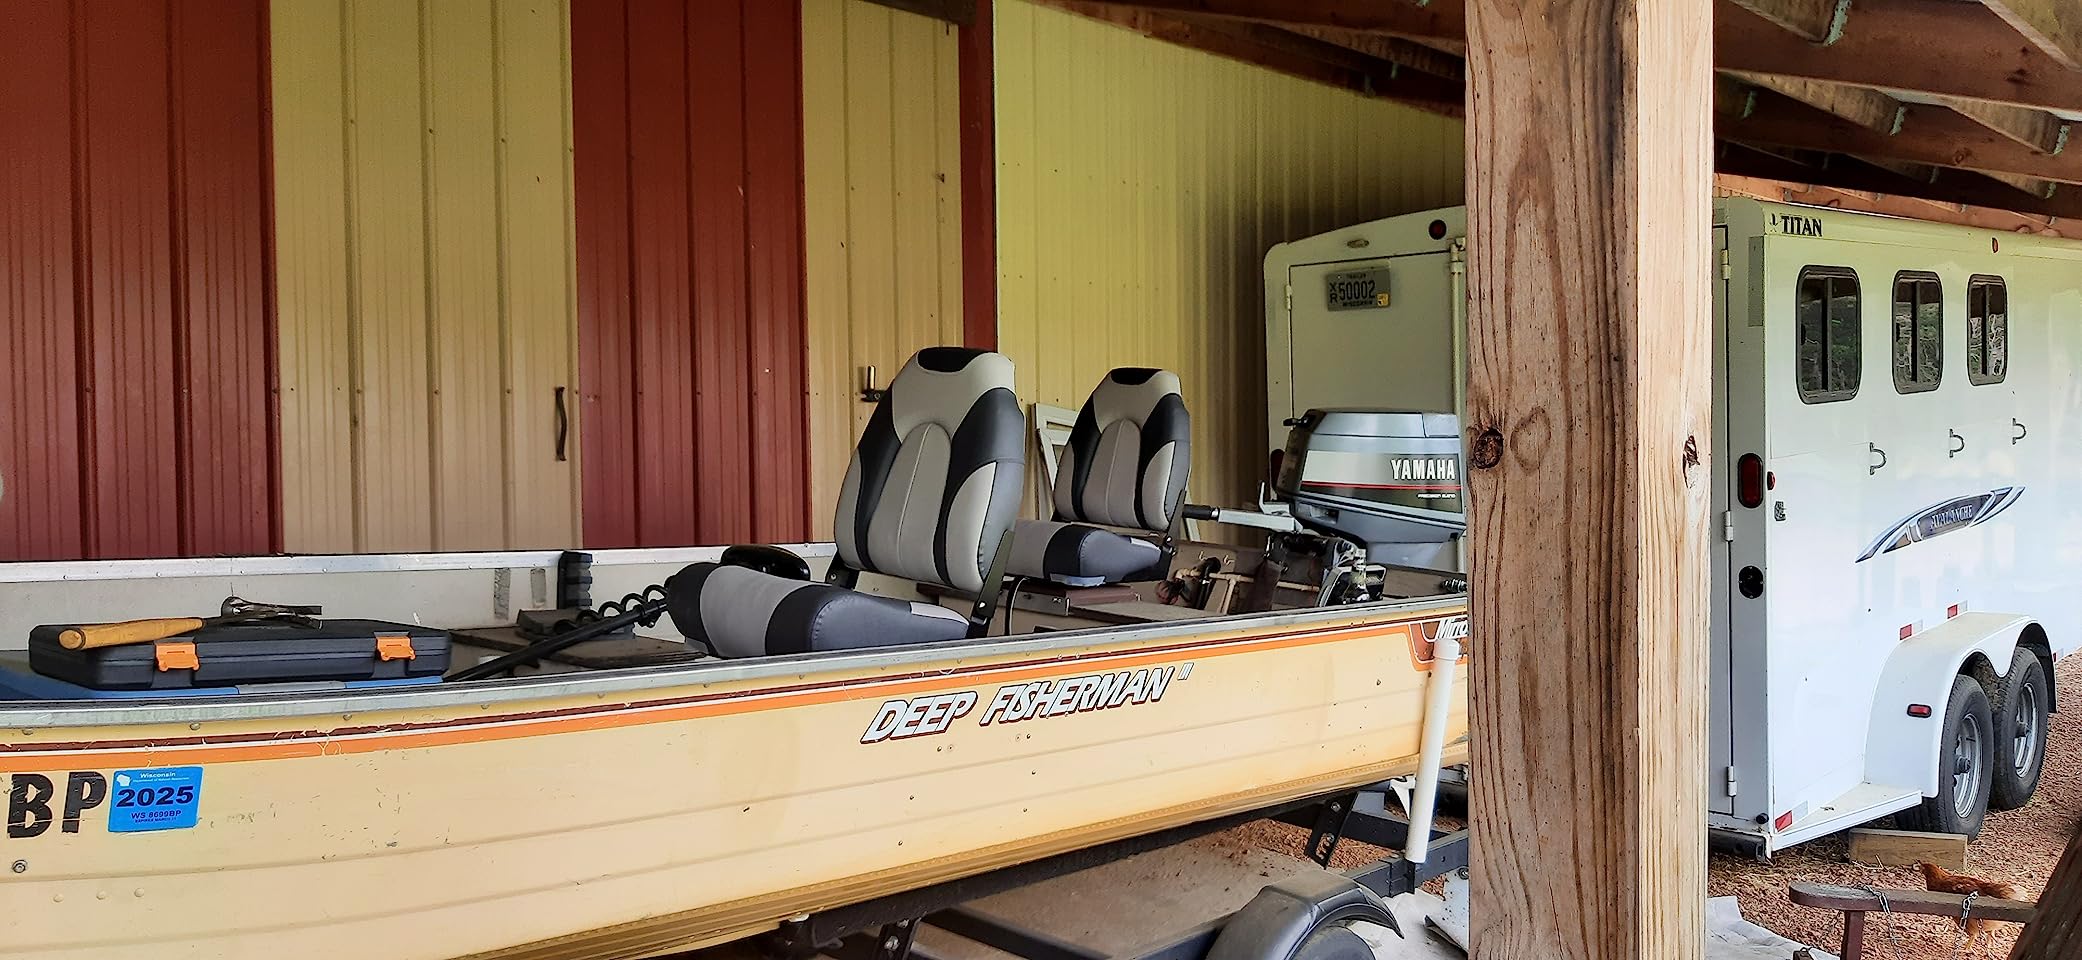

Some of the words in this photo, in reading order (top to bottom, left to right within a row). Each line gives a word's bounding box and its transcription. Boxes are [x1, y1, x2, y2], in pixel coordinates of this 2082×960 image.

[1780, 215, 1823, 238] TITAN
[1338, 280, 1376, 300] 50002
[1390, 458, 1456, 480] YAMAHA
[860, 691, 978, 744] DEEP
[979, 666, 1175, 726] FISHERMAN
[139, 771, 177, 779] Wisconsin
[7, 771, 107, 839] BP
[116, 786, 194, 808] 2025
[131, 811, 146, 819] WS
